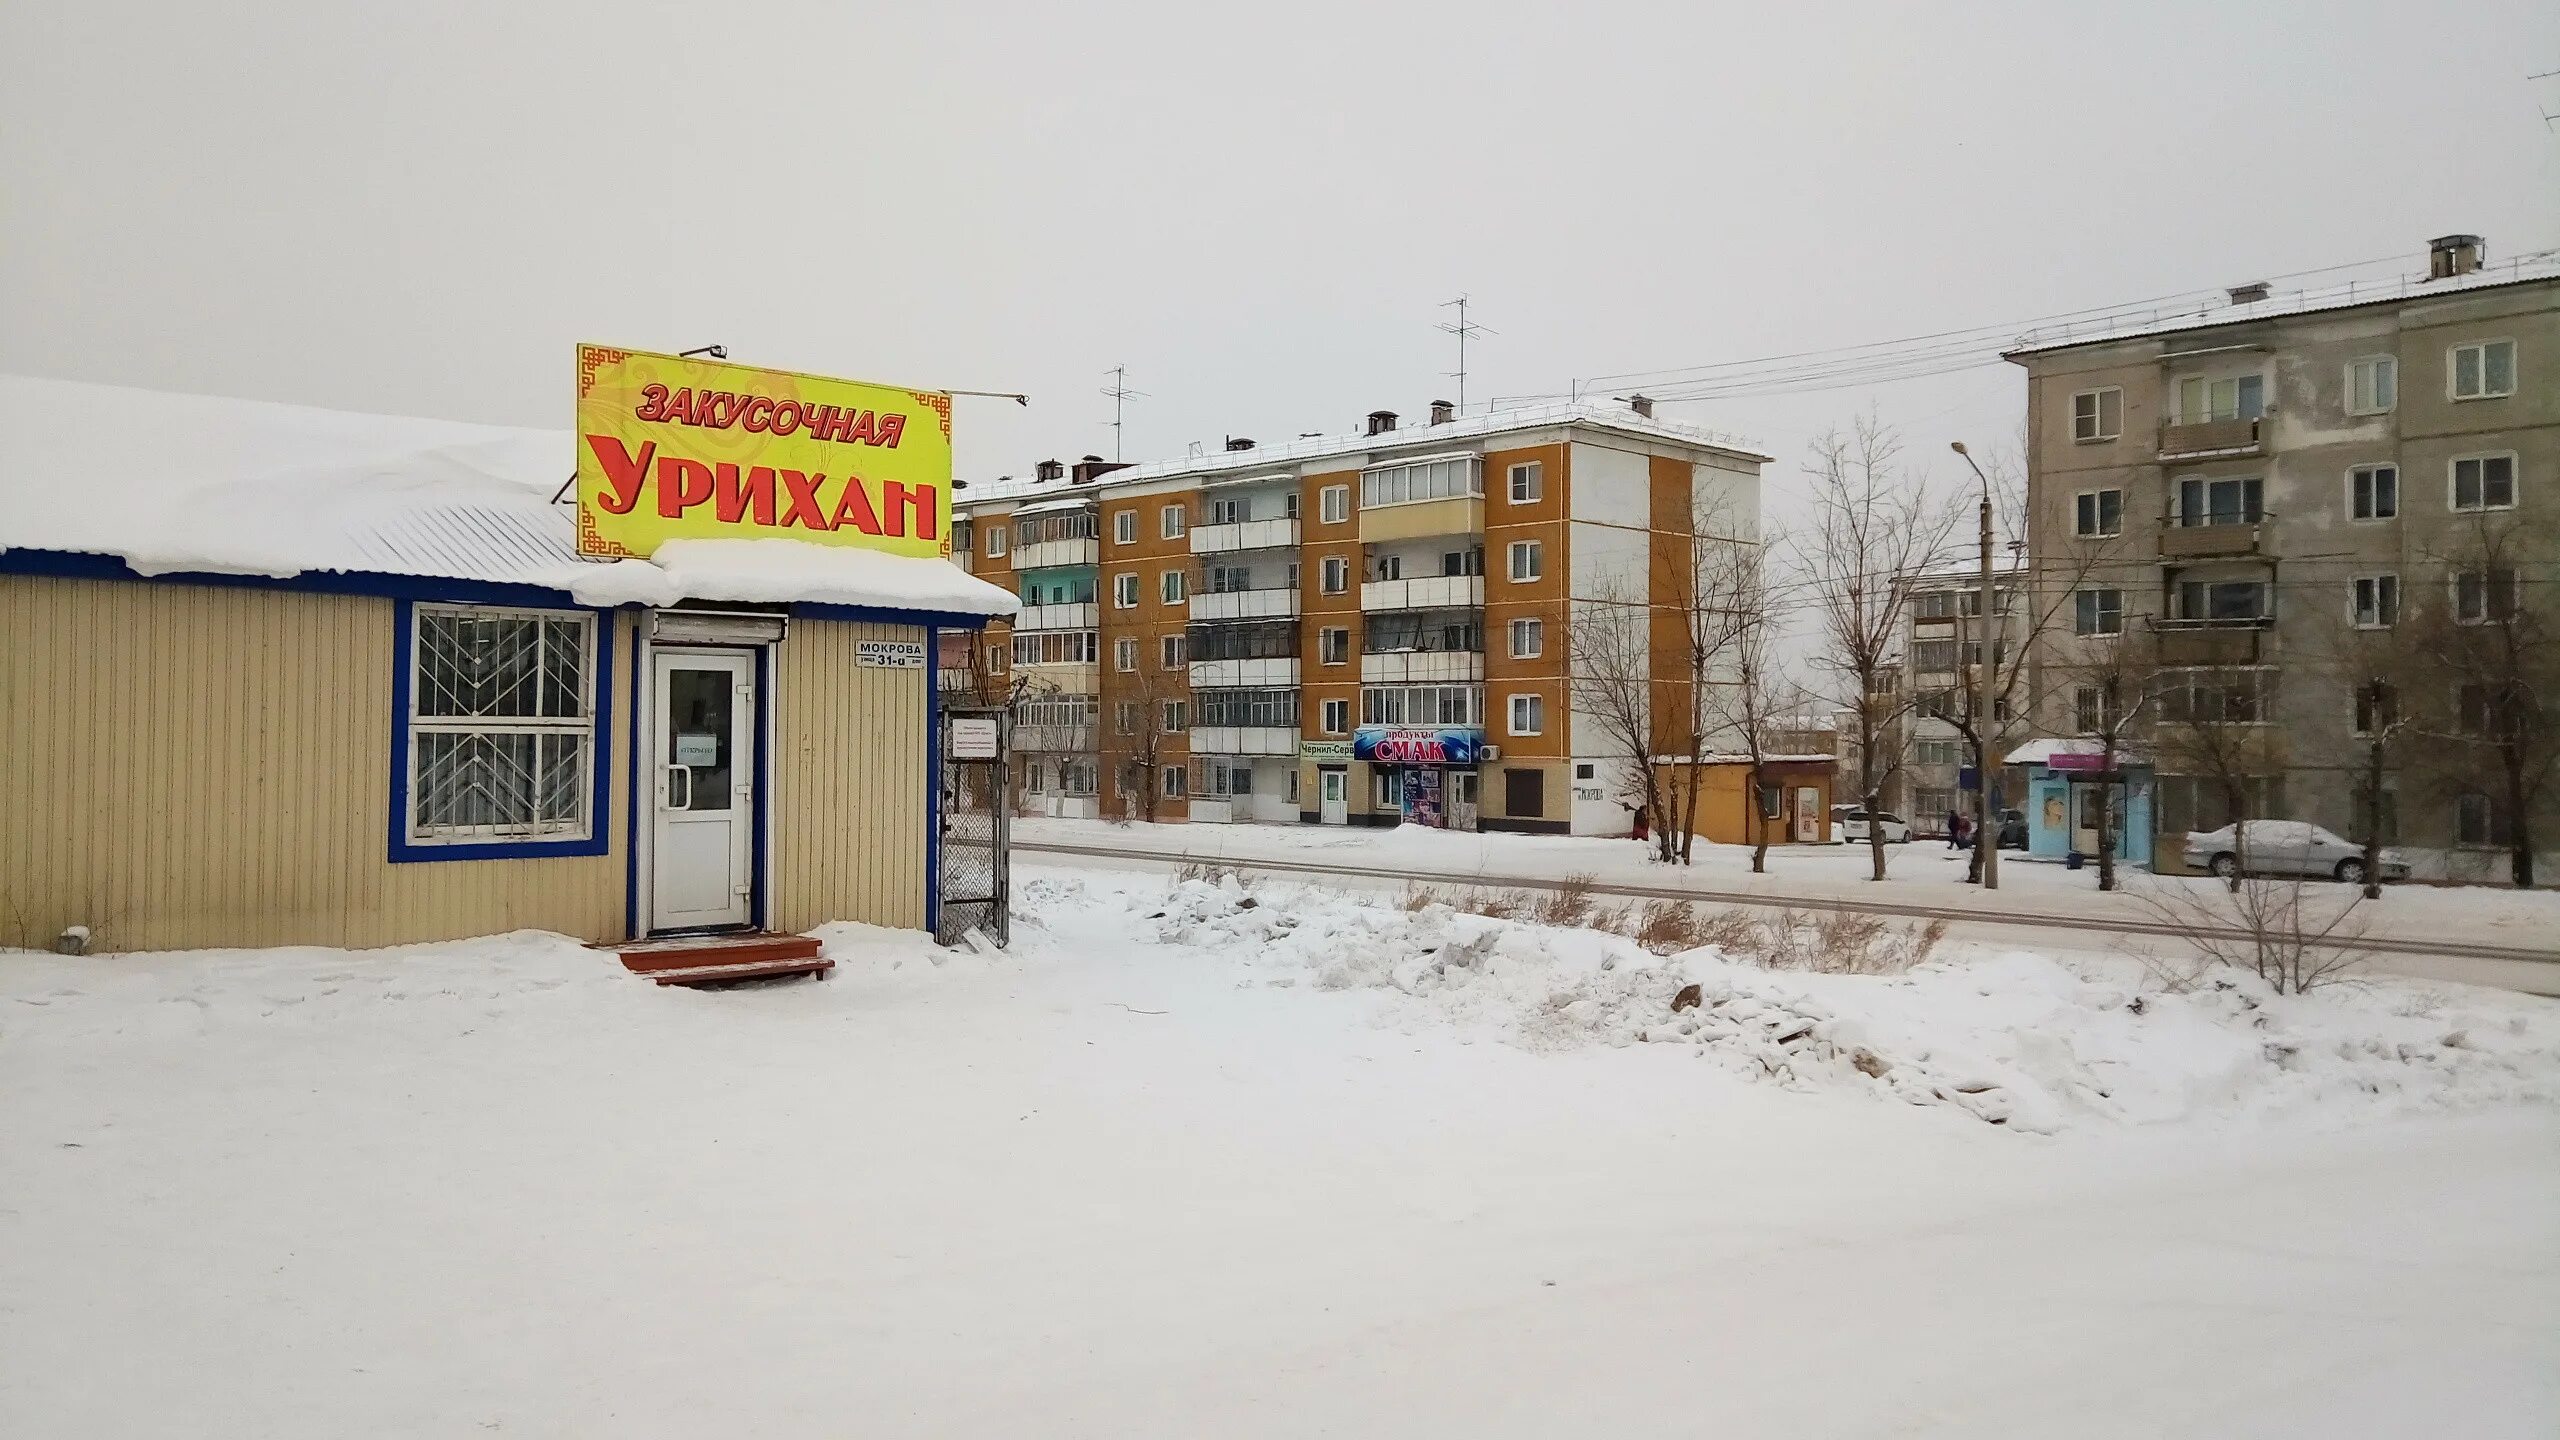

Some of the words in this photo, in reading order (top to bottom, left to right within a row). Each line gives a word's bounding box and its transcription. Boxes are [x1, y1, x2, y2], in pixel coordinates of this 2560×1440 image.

[636, 383, 908, 449] ЗАКУСОЧНАЯ
[585, 433, 938, 541] УРИХАН
[860, 643, 921, 654] МОКРОВА
[877, 655, 906, 666] 31-а
[1374, 740, 1447, 761] СМАК
